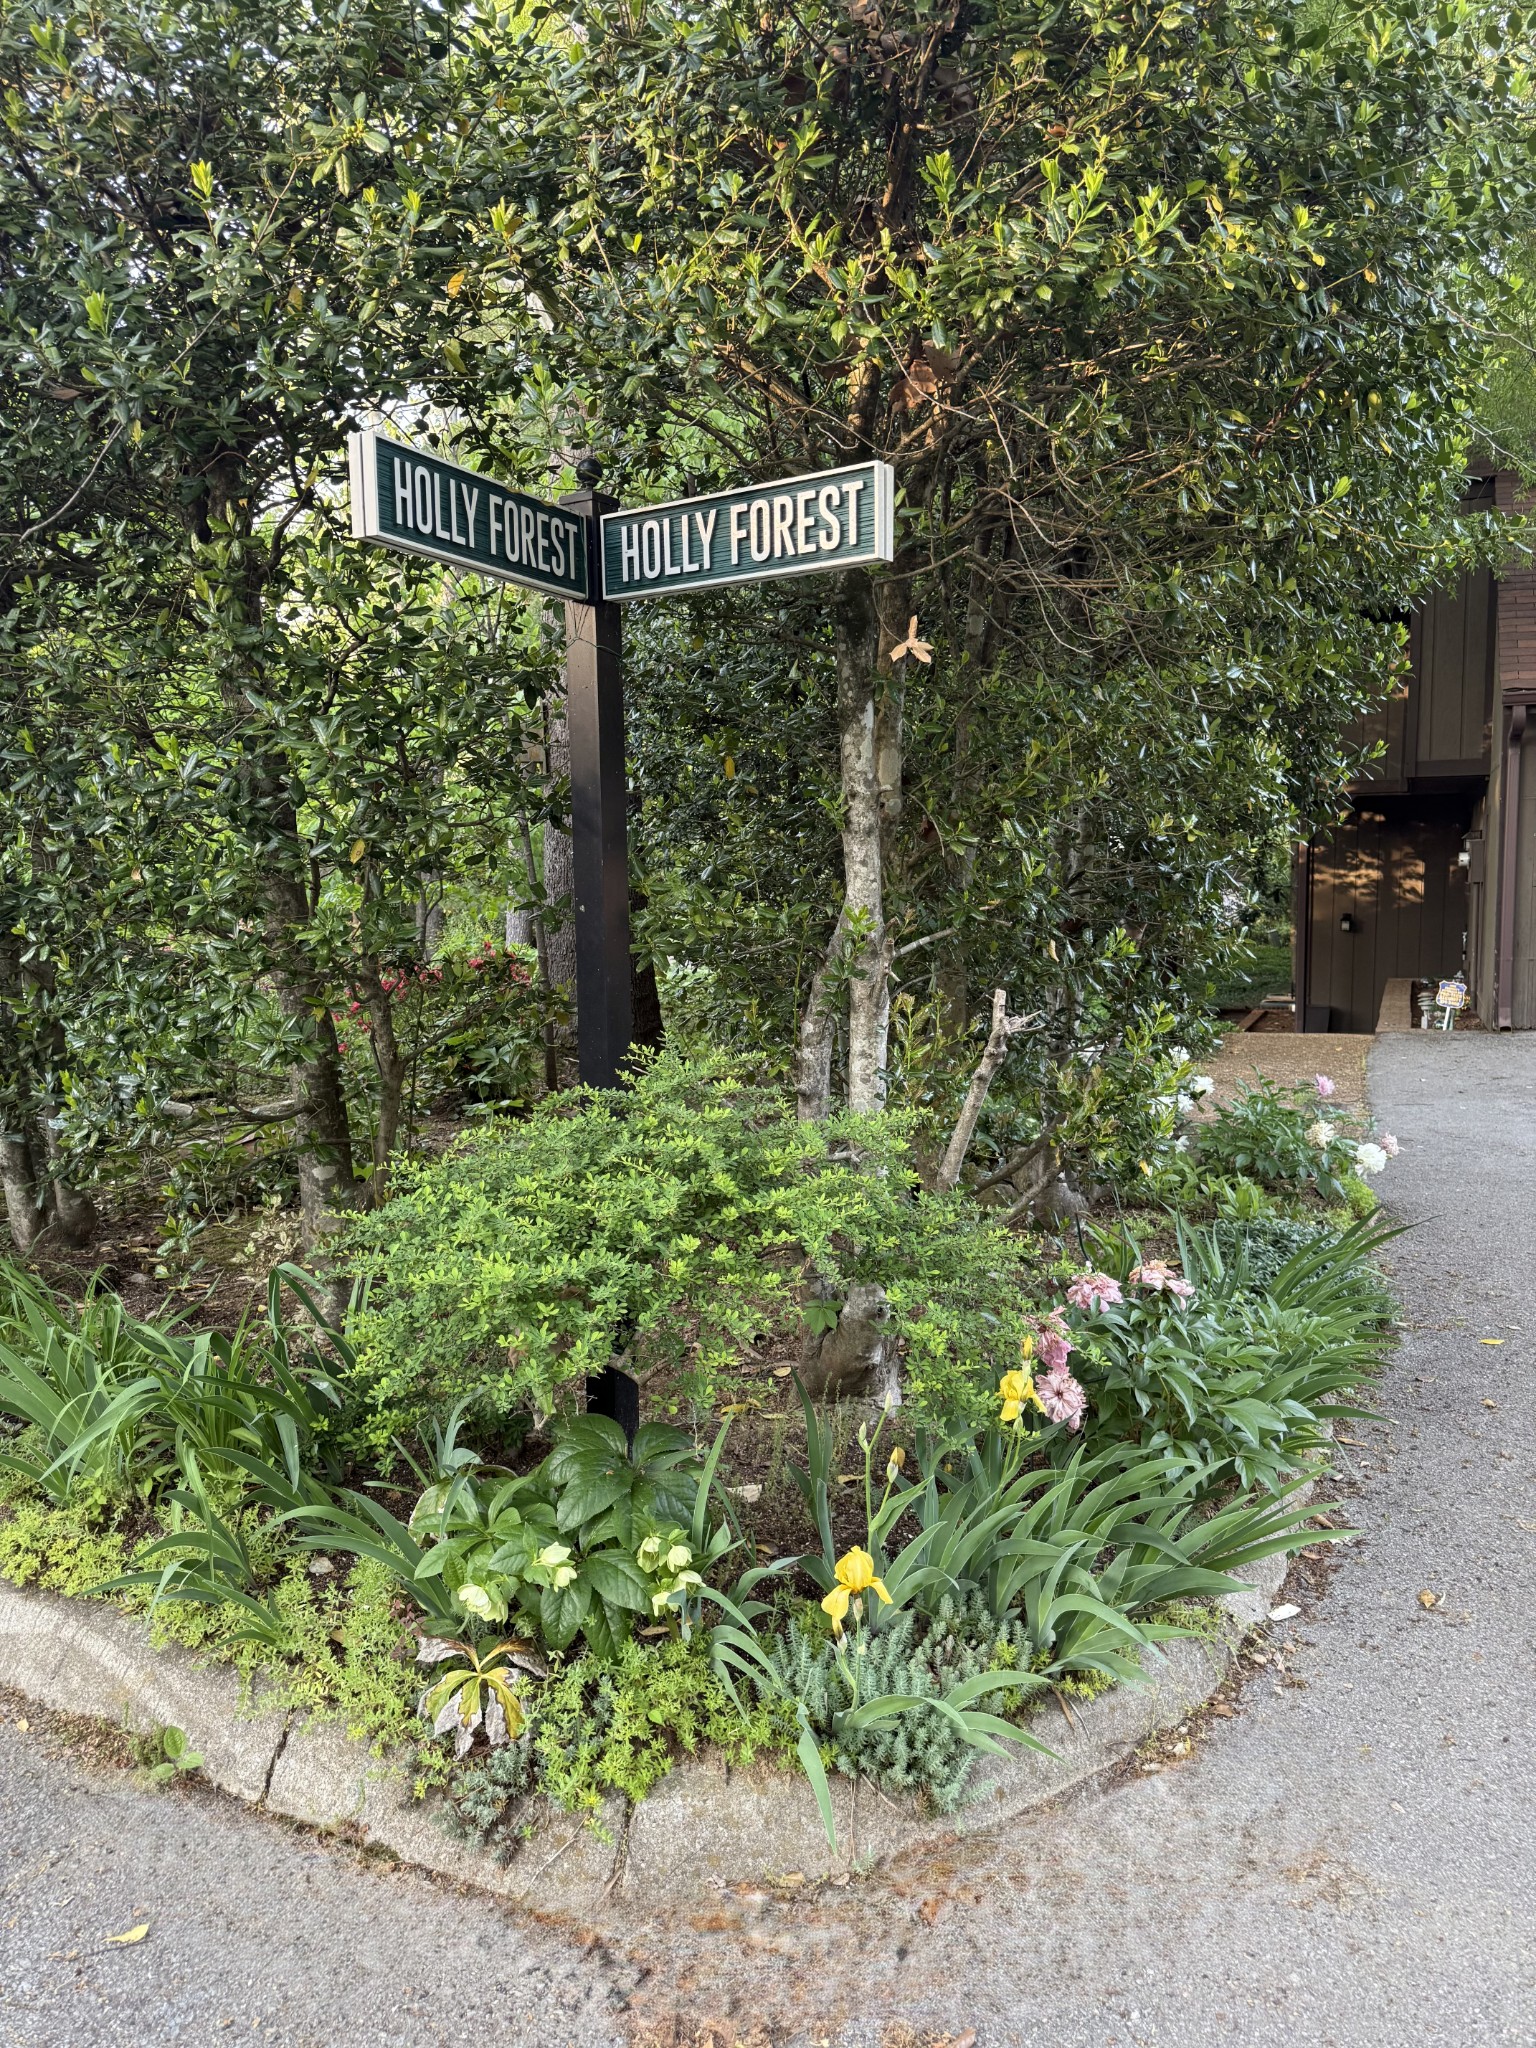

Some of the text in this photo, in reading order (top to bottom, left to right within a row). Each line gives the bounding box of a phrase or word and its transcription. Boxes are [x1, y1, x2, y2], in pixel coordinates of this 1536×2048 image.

[393, 457, 578, 580] HOLLY FOREST
[620, 480, 864, 583] HOLLY FOREST
